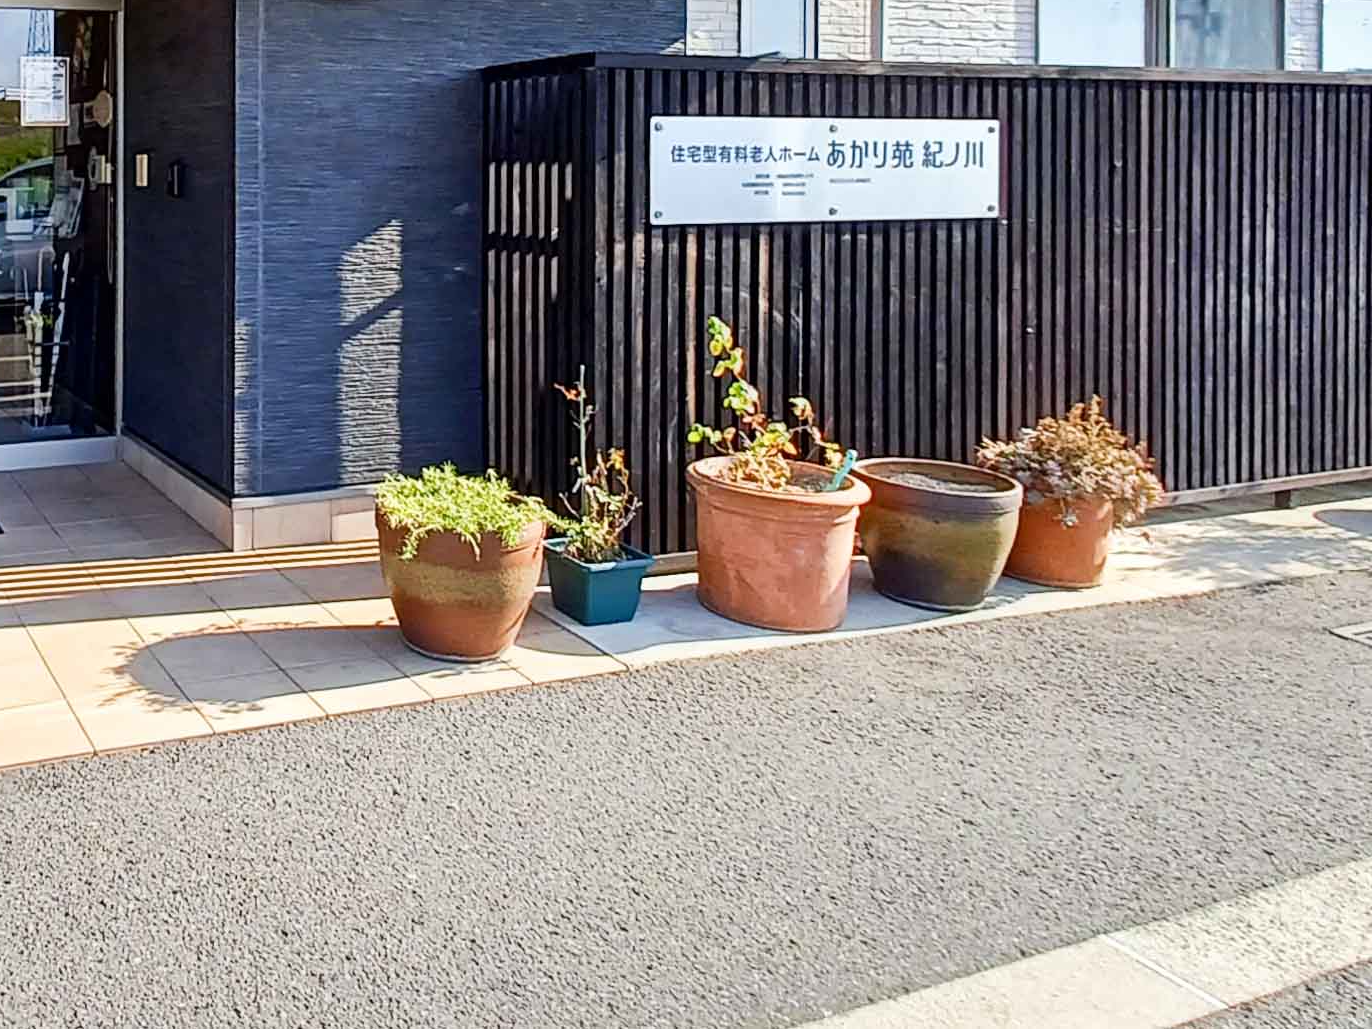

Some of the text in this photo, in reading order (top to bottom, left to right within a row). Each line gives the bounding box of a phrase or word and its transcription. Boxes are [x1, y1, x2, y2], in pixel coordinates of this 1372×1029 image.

[671, 140, 984, 169] 住宅型有料老人ホーム あかり苑 紀ノ川
